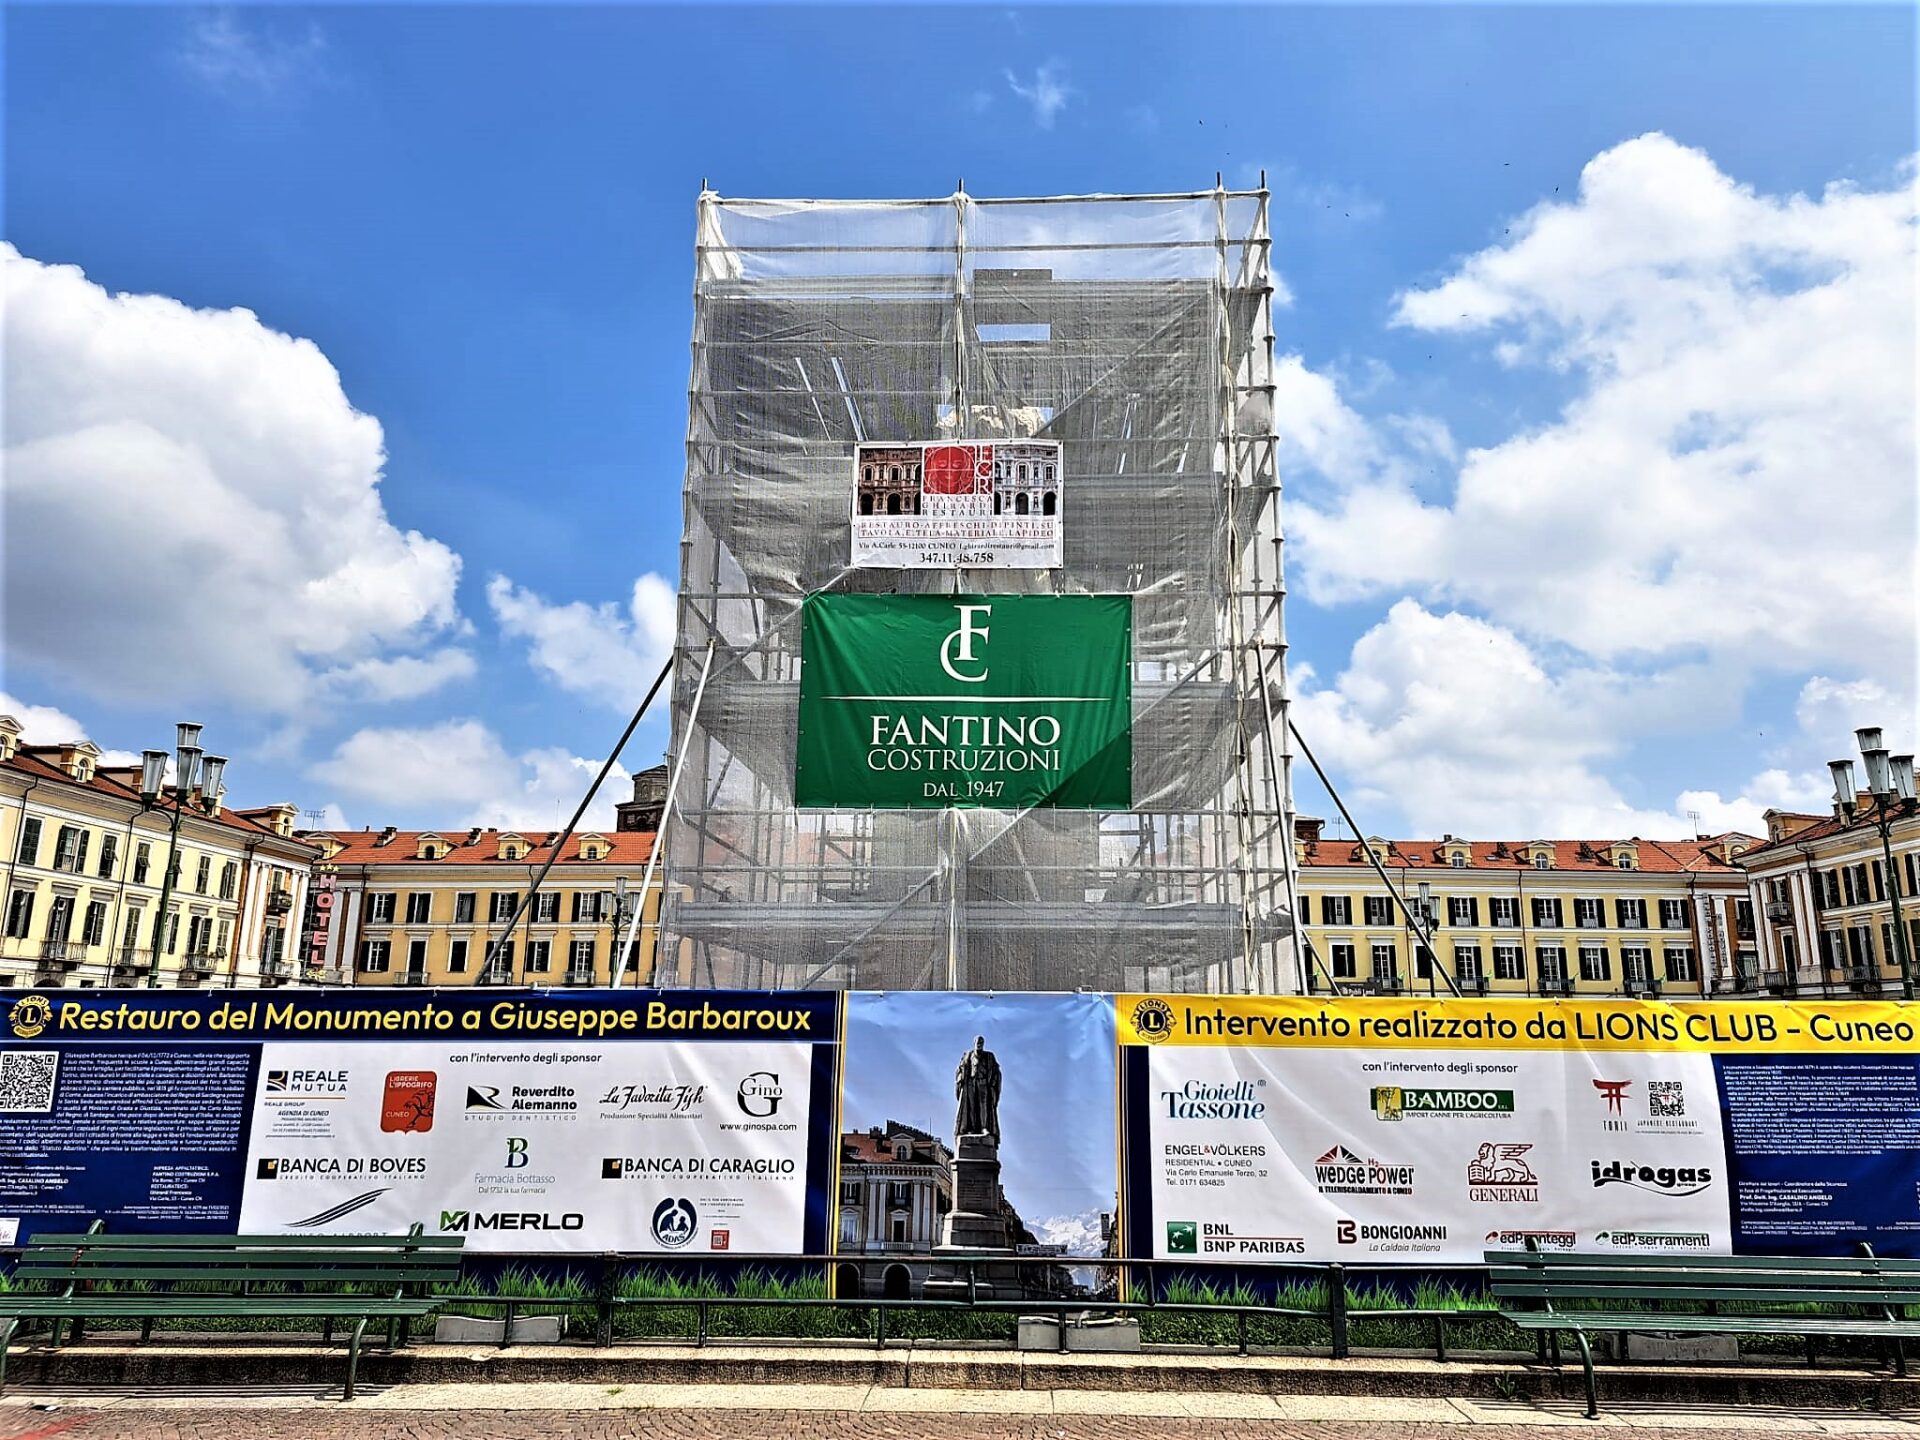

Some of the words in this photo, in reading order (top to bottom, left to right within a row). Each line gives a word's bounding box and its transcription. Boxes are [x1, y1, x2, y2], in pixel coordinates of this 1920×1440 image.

[922, 495, 993, 503] FRANCESCA
[928, 542, 956, 550] CUNEO
[920, 552, 994, 564] 347.11.48.758
[870, 715, 1061, 746] FANTINO
[867, 749, 1060, 772] COSTRUZIONI
[923, 782, 958, 798] DAL
[966, 781, 1005, 798] 1947
[311, 874, 337, 964] HOTEL
[20, 996, 48, 1006] LIONS
[1139, 1000, 1167, 1010] LIONS
[25, 1007, 37, 1024] L
[59, 1002, 202, 1031] Restauro
[208, 1002, 256, 1031] del
[264, 1002, 454, 1030] Monumento
[462, 1010, 480, 1030] a
[490, 1002, 638, 1036] Giuseppe
[646, 1002, 812, 1030] Barbaroux
[1148, 1012, 1160, 1028] L
[1185, 1008, 1350, 1036] Intervento
[1359, 1009, 1517, 1039] realizzato
[1525, 1011, 1567, 1040] da
[1575, 1012, 1679, 1041] LIONS
[1686, 1014, 1778, 1042] CLUB
[1809, 1014, 1914, 1042] Cuneo
[449, 1054, 468, 1063] con
[470, 1052, 531, 1063] l'intervento
[533, 1052, 558, 1065] degli
[560, 1054, 602, 1065] sponsor
[1362, 1063, 1382, 1072] con
[1384, 1061, 1445, 1072] l'intervento
[1447, 1062, 1473, 1075] degli
[1475, 1064, 1518, 1075] sponsor
[292, 1070, 349, 1082] REALE
[290, 1083, 347, 1092] MUTUA
[511, 1086, 575, 1097] Reverdito
[739, 1077, 783, 1097] Gino
[1184, 1080, 1257, 1100] Gioielli
[599, 1085, 620, 1104] La
[619, 1085, 674, 1110] Favorita
[1404, 1091, 1498, 1109] BAMBOO
[511, 1099, 578, 1110] Alemanno
[1161, 1091, 1265, 1119] Tassone
[669, 1112, 703, 1120] Alimentari
[719, 1122, 797, 1132] www.ginospa.com
[1165, 1144, 1266, 1156] ENGEL&VÖLKERS
[280, 1158, 341, 1173] BANCA
[347, 1158, 364, 1172] DI
[369, 1158, 426, 1173] BOVES
[625, 1158, 683, 1172] BANCA
[688, 1159, 704, 1172] DI
[709, 1159, 795, 1174] CARAGLIO
[1165, 1159, 1215, 1167] RESIDENTIAL
[474, 1173, 514, 1184] Farmacia
[516, 1173, 556, 1184] Bottasso
[1199, 1169, 1234, 1177] Emanuele
[1236, 1169, 1257, 1178] Terzo,
[1591, 1160, 1712, 1188] idrogas
[521, 1186, 546, 1194] farmacia
[1393, 1187, 1412, 1195] CUNEO
[1469, 1188, 1538, 1202] GENERALI
[474, 1213, 584, 1230] MERLO
[1203, 1223, 1234, 1235] BNL
[1361, 1225, 1447, 1240] BONGIOANNI
[662, 1233, 686, 1243] ADAS
[1204, 1241, 1236, 1252] BNP
[1240, 1241, 1305, 1253] PARIBAS
[1369, 1243, 1378, 1251] La
[1380, 1243, 1409, 1251] Caldaia
[1411, 1243, 1441, 1251] Italiana
